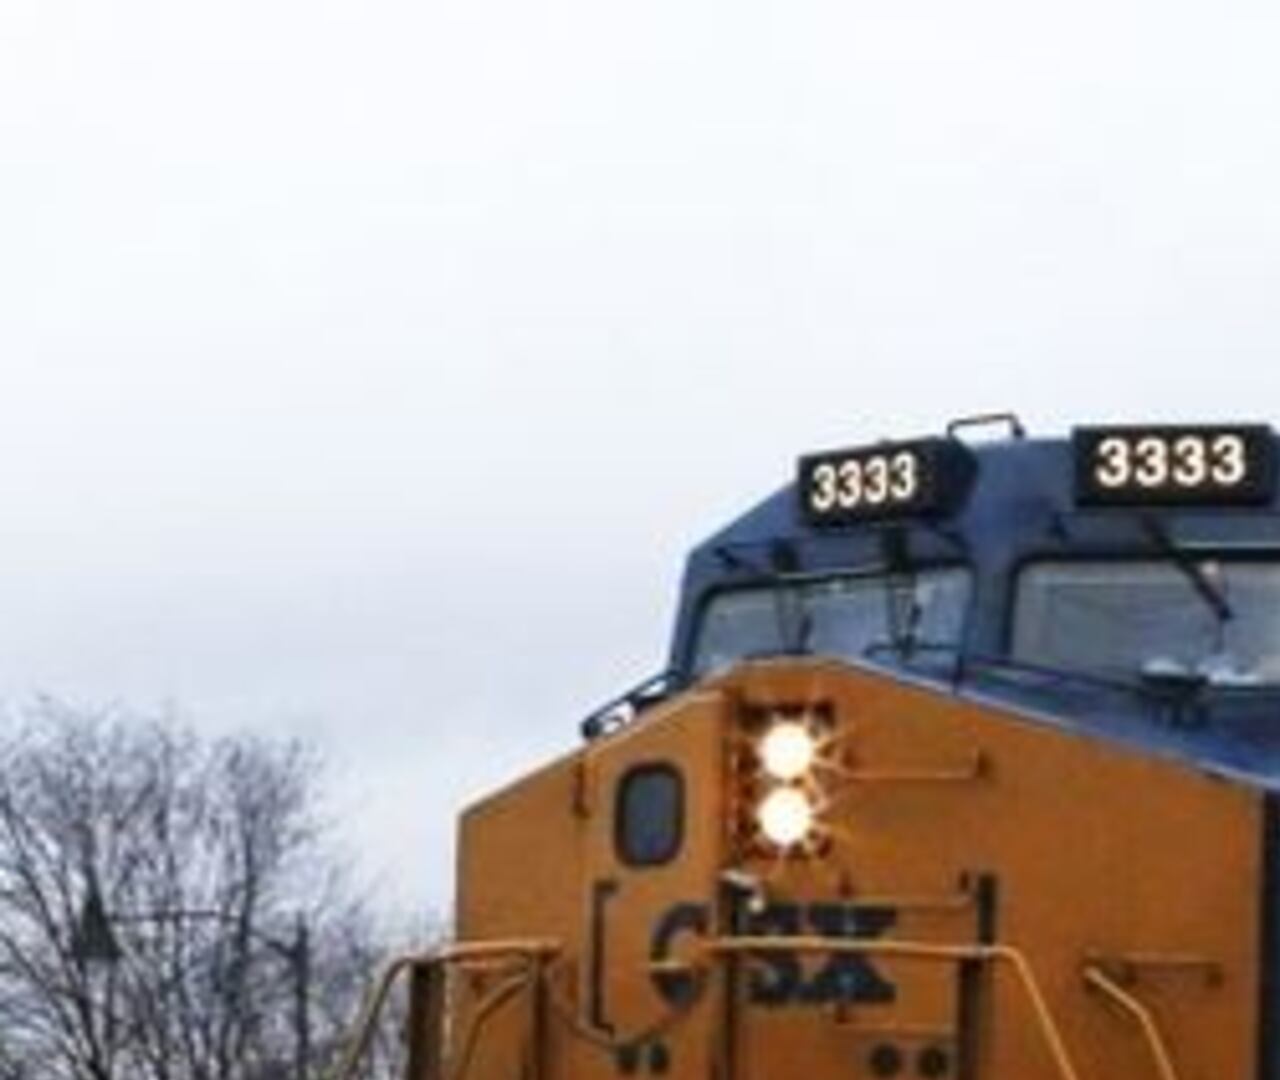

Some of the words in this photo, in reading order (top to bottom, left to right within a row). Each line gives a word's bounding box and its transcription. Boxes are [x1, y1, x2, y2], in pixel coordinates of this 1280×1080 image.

[811, 452, 917, 511] 3333
[1095, 434, 1247, 488] 3333
[649, 903, 897, 1010] CSX
